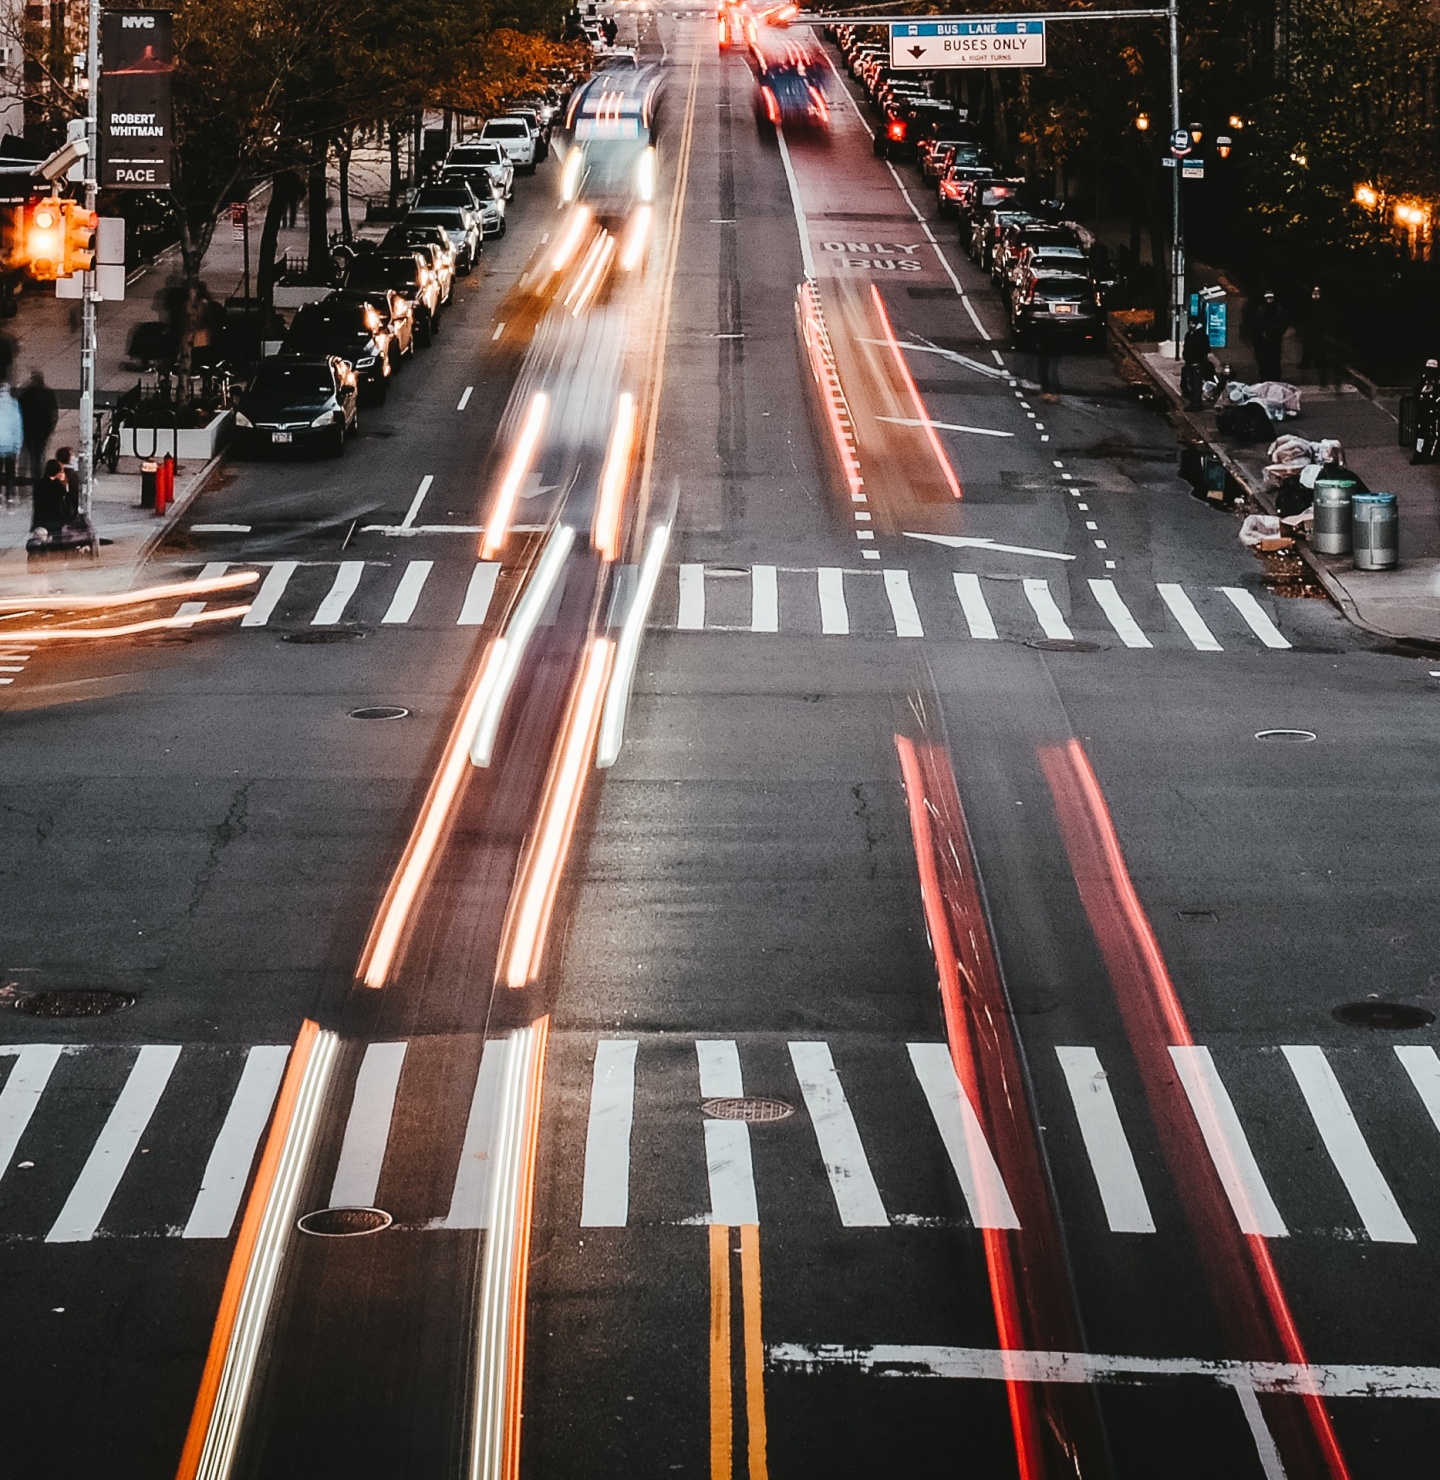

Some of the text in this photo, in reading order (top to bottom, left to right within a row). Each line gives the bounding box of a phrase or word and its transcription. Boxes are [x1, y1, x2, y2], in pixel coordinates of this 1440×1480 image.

[122, 16, 155, 29] NYC
[937, 23, 997, 35] BUS LANE
[944, 38, 1027, 51] BUSES ONLY
[111, 113, 155, 124] ROBERT
[110, 126, 163, 137] WHITMAN
[116, 170, 156, 182] PACE
[823, 242, 920, 254] ONLY
[842, 259, 922, 271] BUS
